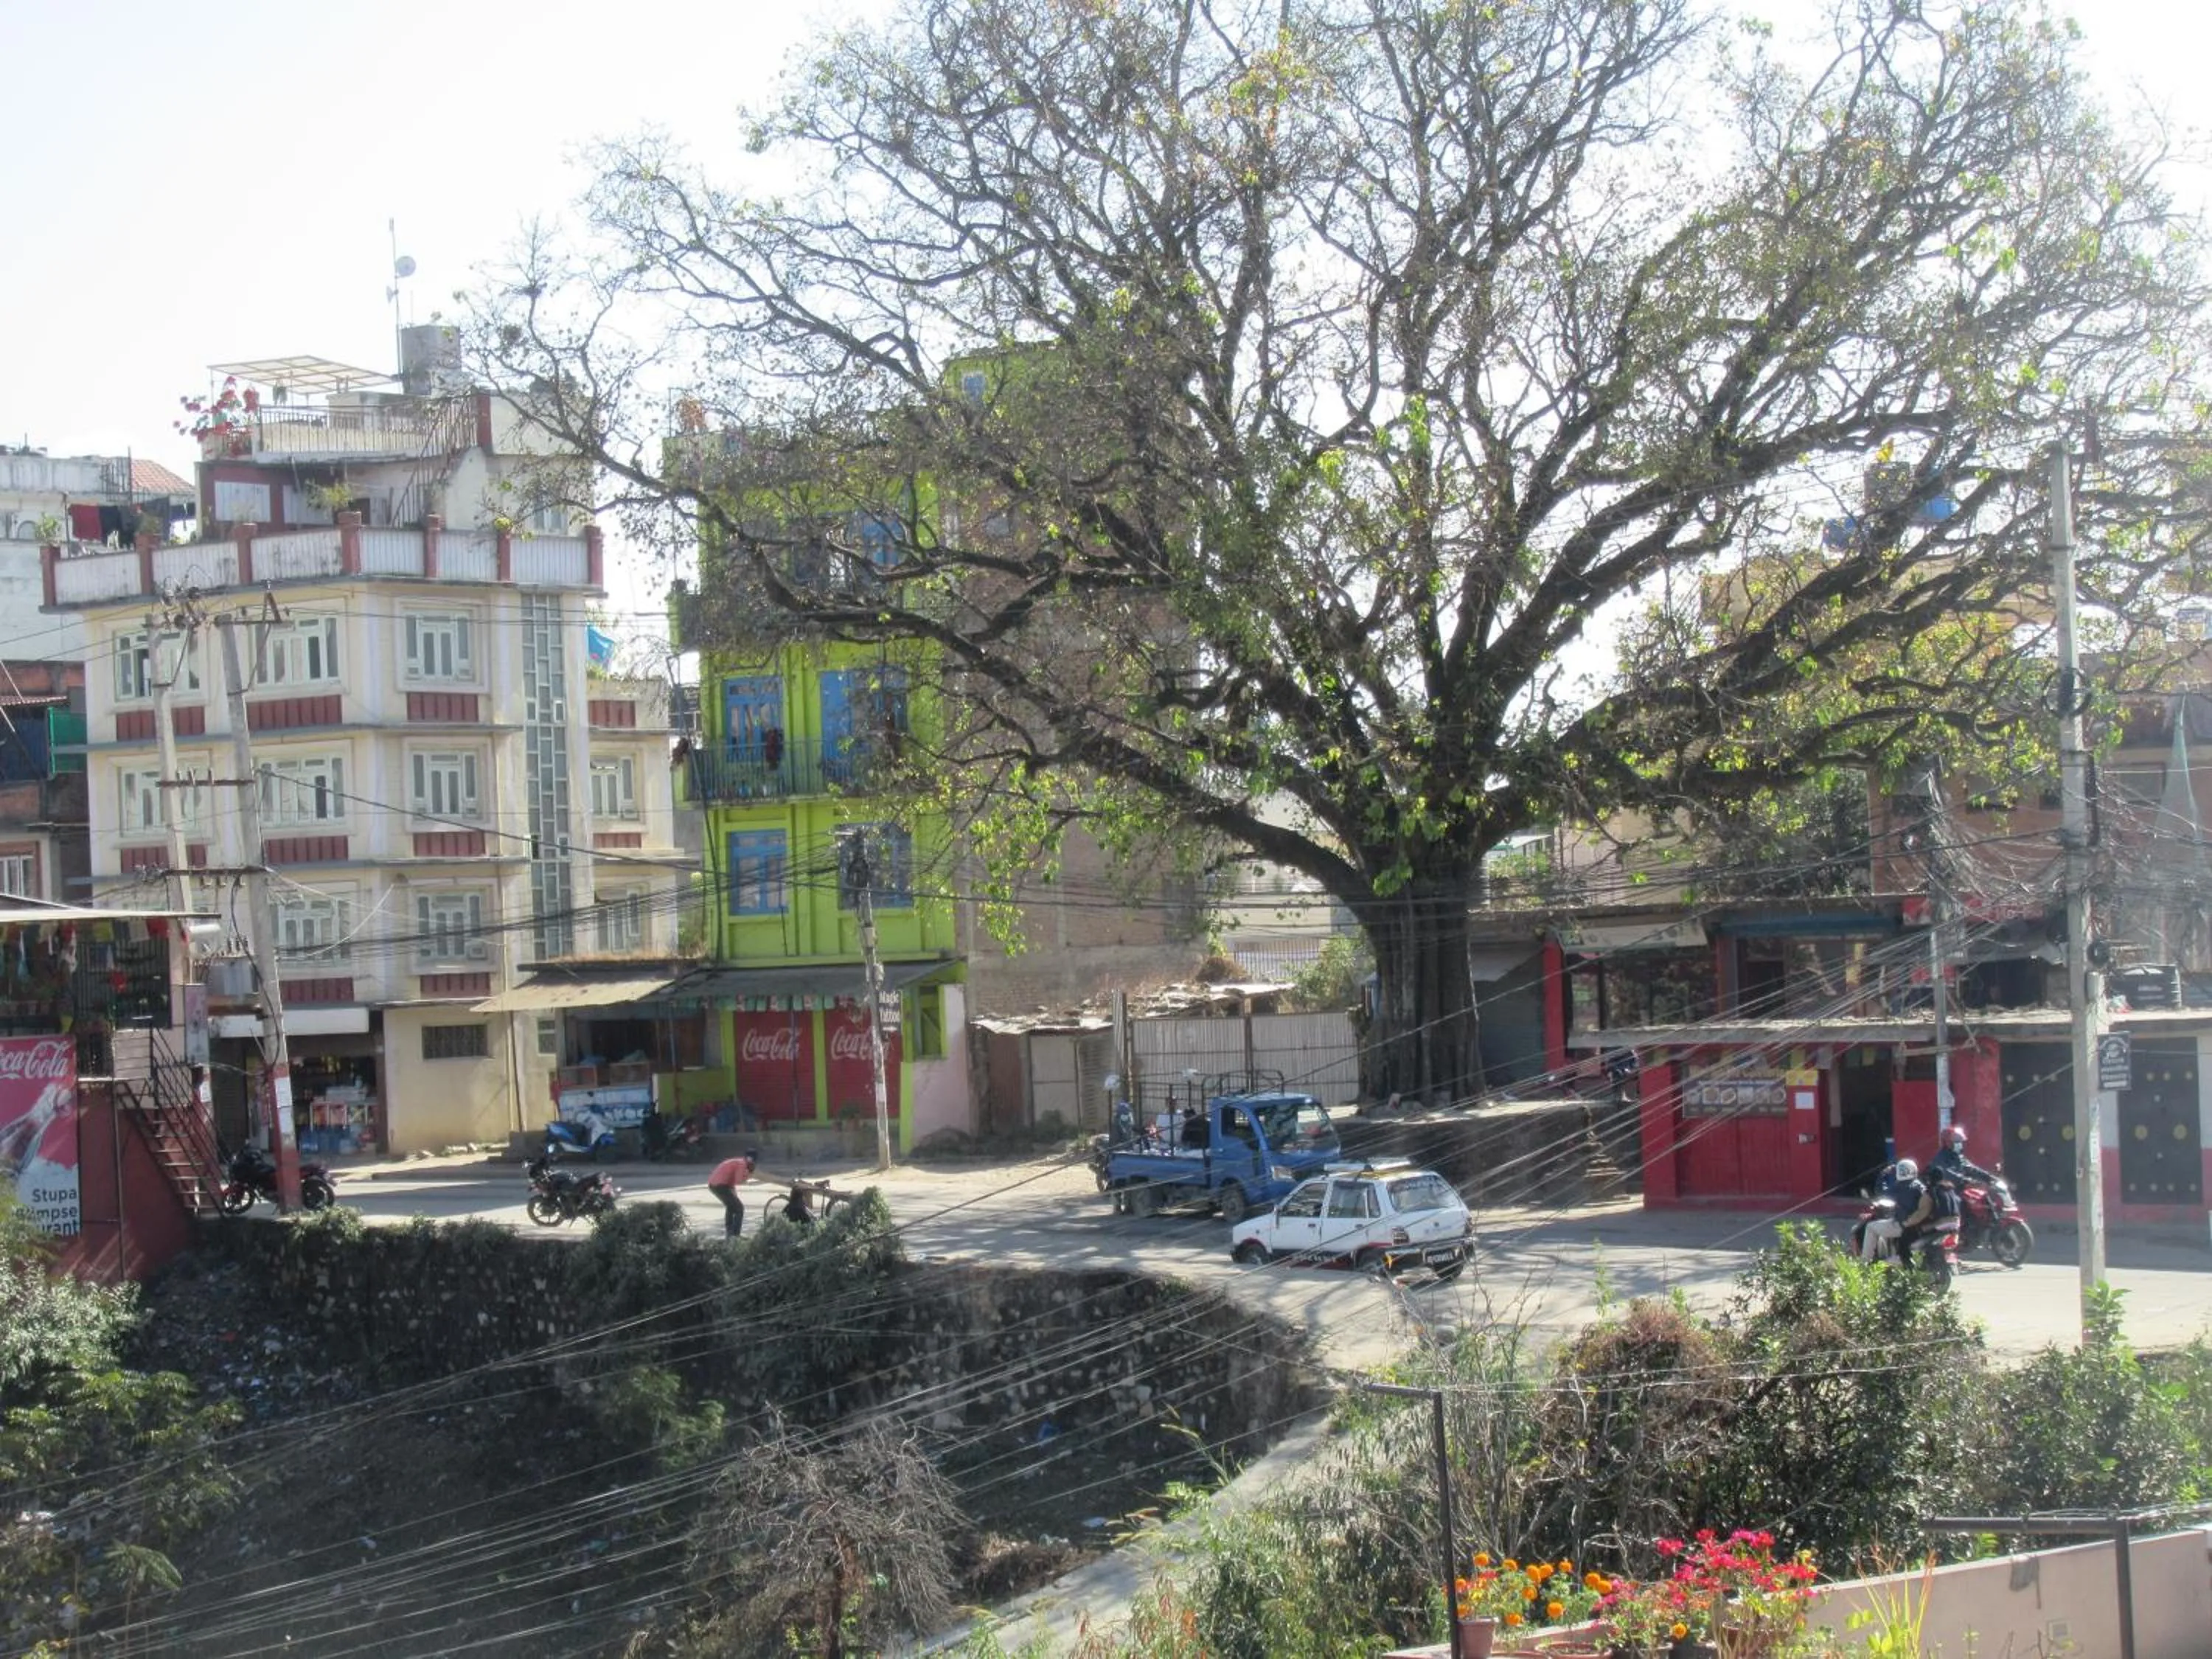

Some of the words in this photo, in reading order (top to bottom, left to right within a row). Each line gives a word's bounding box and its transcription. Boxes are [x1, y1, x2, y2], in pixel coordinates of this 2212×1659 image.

[0, 1040, 70, 1079] oca-Cola
[830, 1026, 891, 1061] Coca-Coa
[32, 1188, 77, 1204] Stupa
